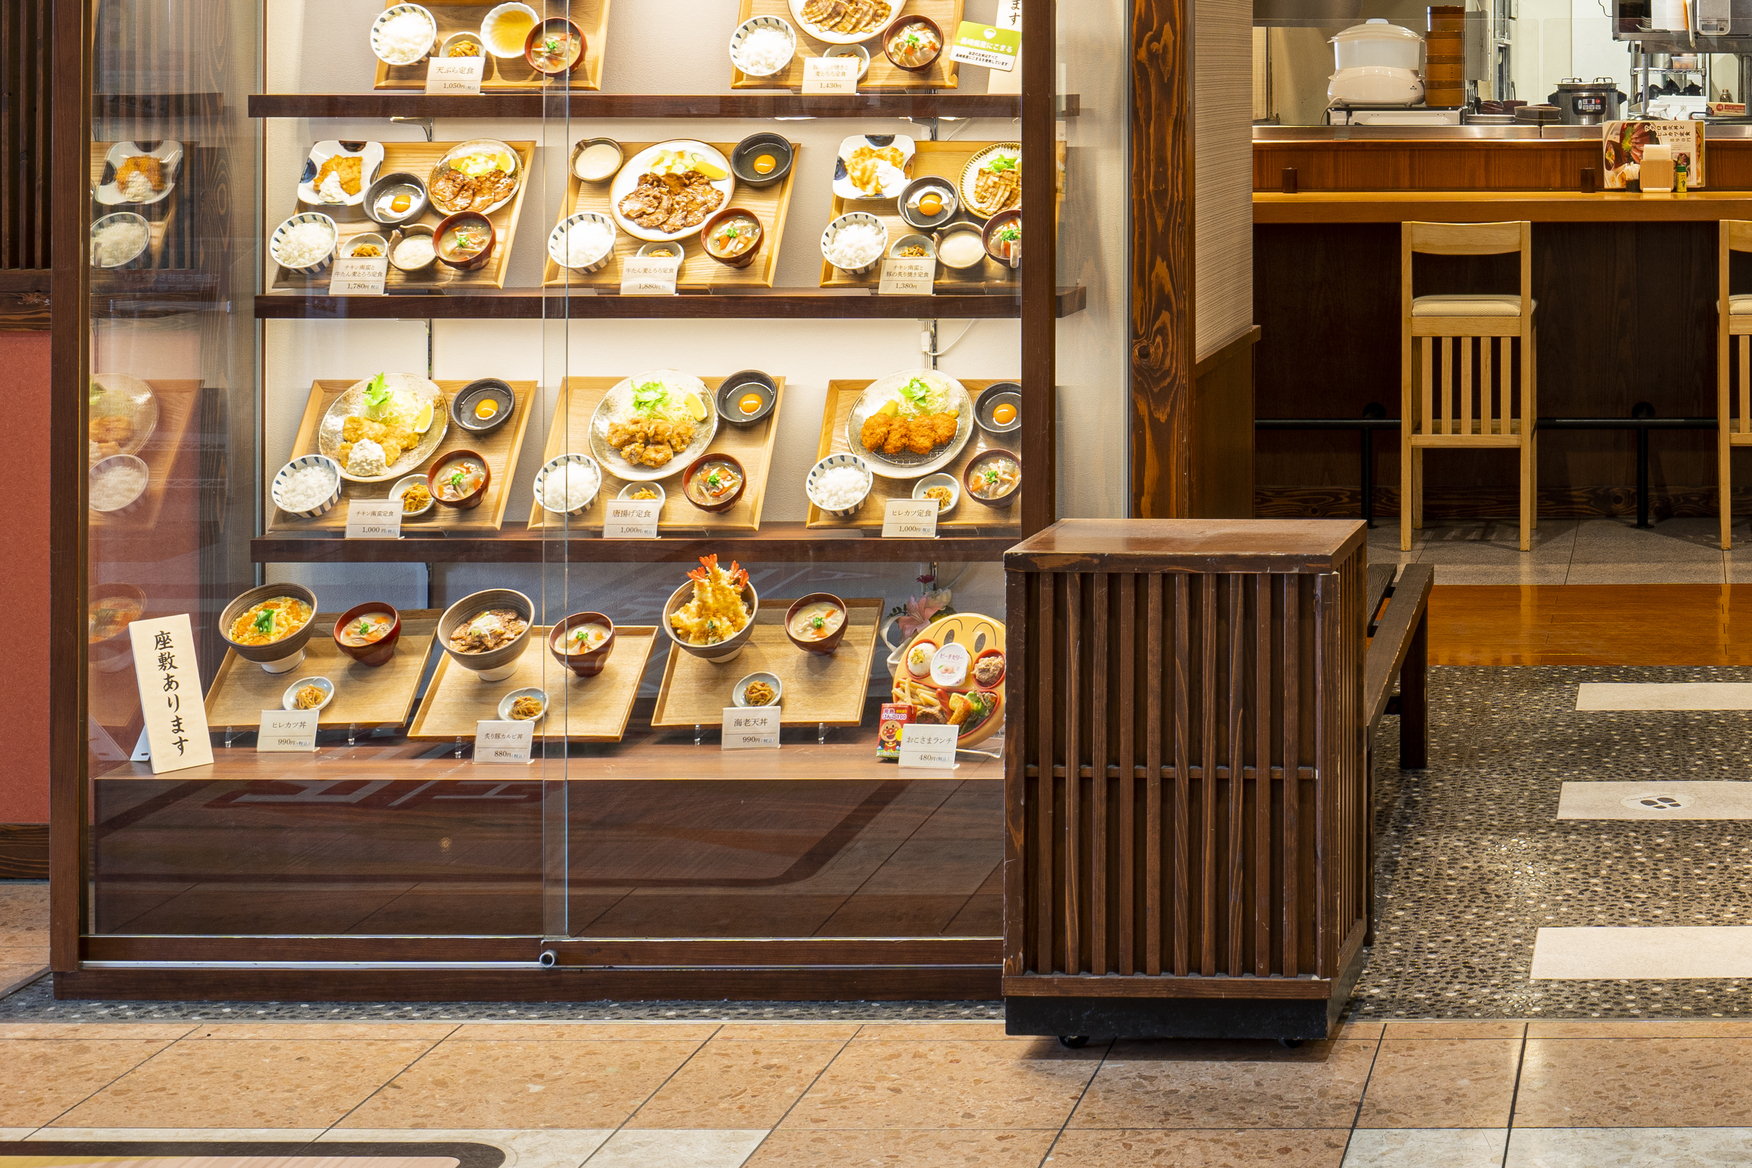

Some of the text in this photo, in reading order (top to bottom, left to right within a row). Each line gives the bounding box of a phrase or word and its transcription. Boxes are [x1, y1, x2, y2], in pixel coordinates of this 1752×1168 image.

[436, 66, 475, 75] 天ぷら定食
[356, 510, 394, 518] チキン南蛮定食
[612, 509, 652, 518] 唐揚げ定食
[892, 509, 932, 517] ヒレカツ定食
[153, 629, 190, 758] 座敷あります
[272, 721, 307, 729] ヒレカツ丼
[733, 717, 769, 727] 海老天丼
[906, 736, 953, 744] おこさまランチ
